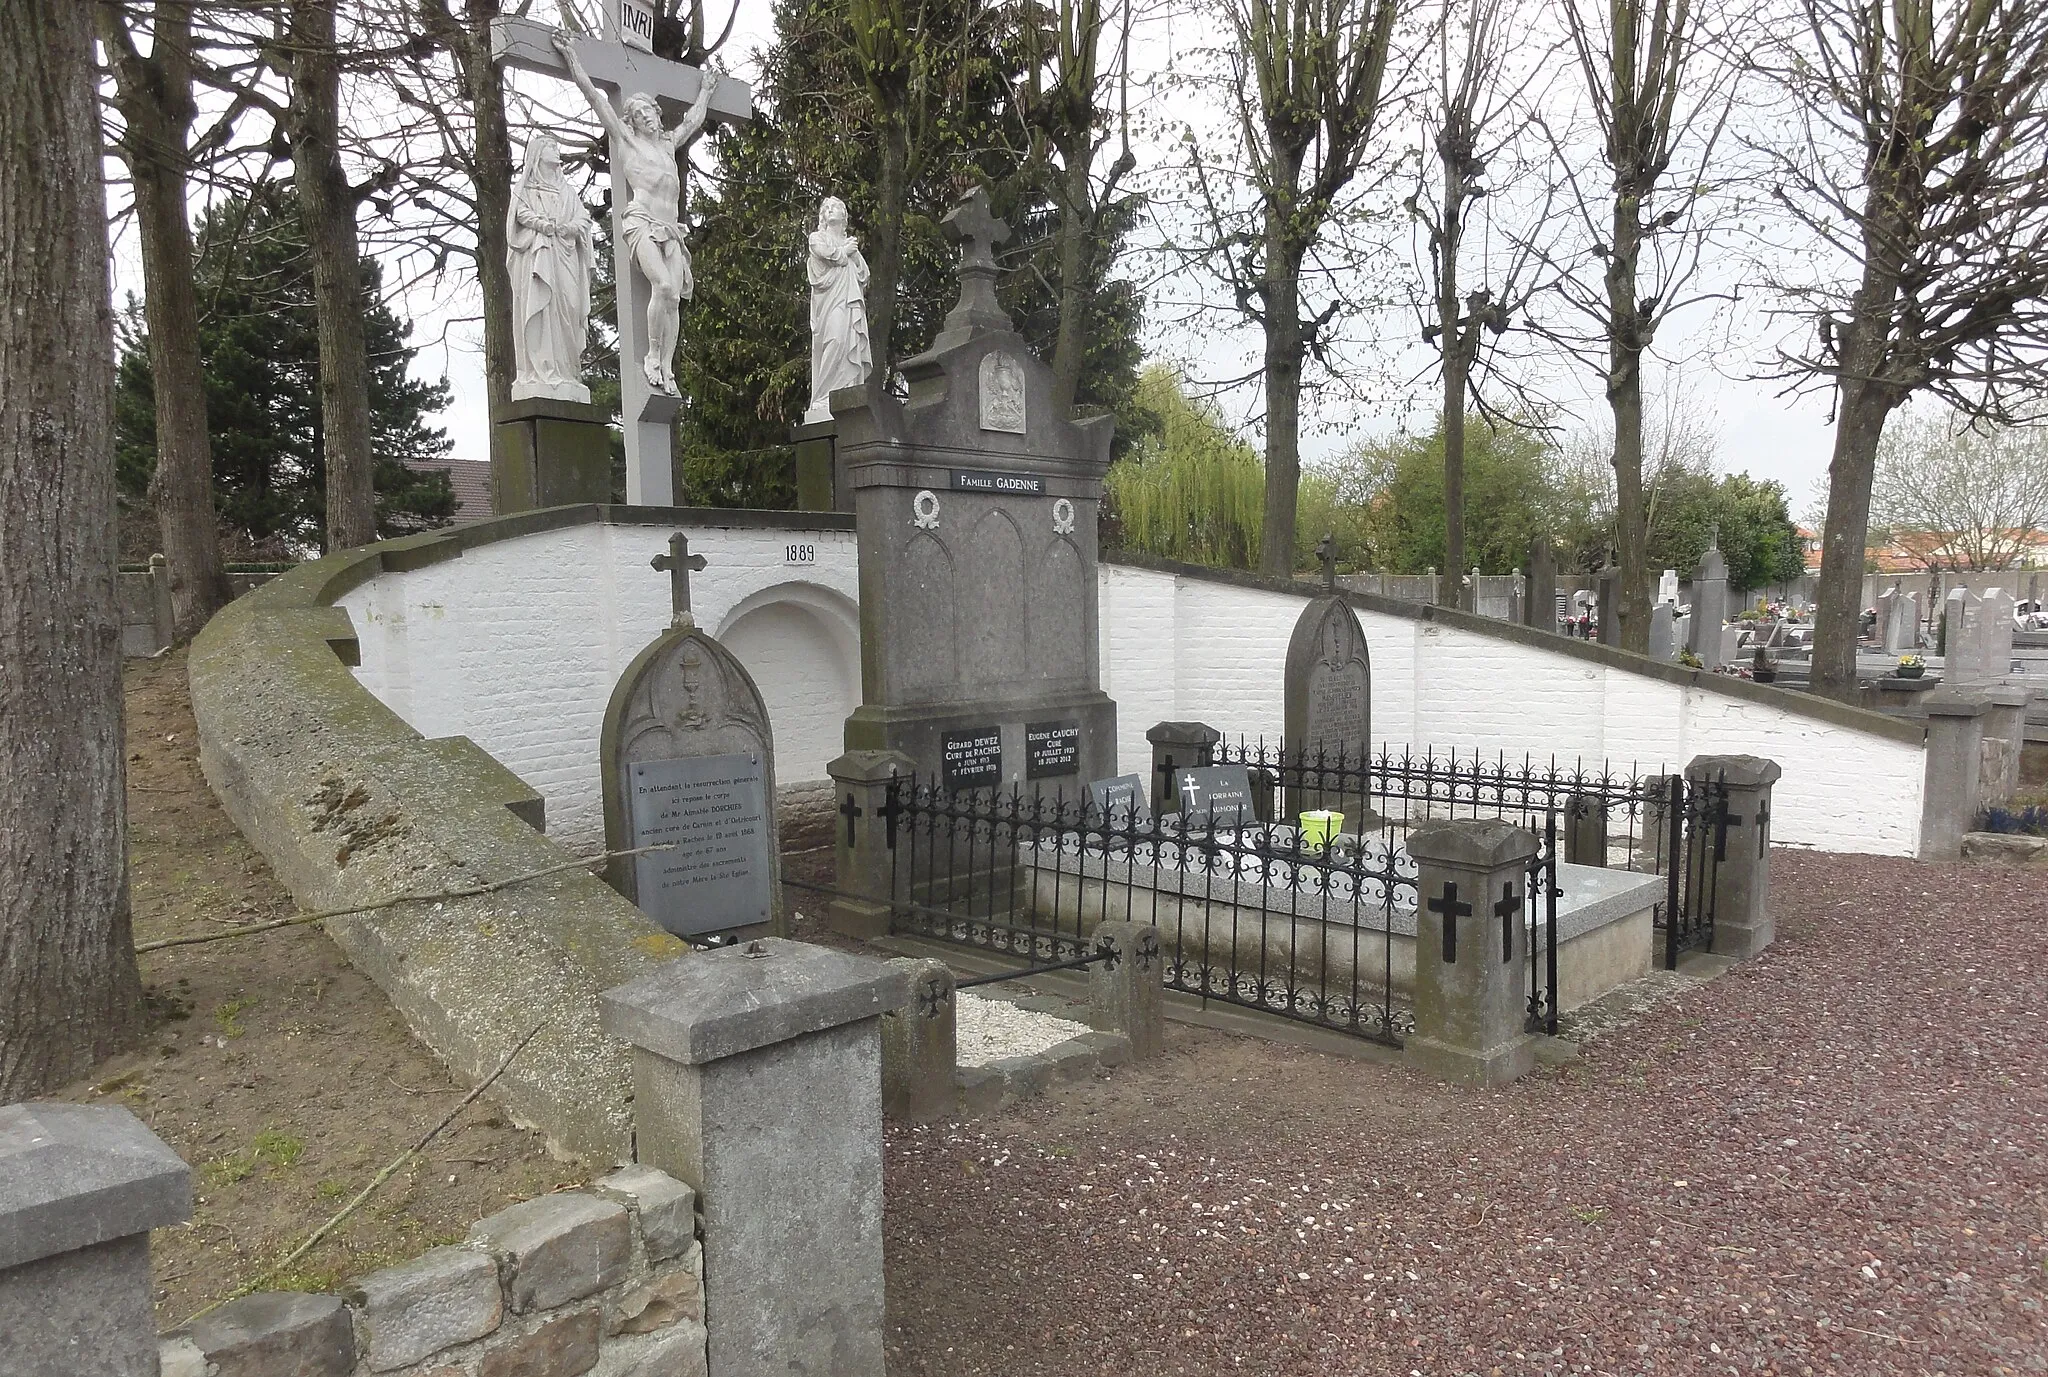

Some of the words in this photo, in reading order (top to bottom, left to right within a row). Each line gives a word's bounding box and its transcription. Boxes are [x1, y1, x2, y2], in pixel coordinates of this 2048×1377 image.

[623, 2, 653, 40] INRI
[961, 475, 993, 488] FAMILLE
[996, 477, 1039, 491] GADENNE
[785, 544, 814, 562] 1889
[1052, 728, 1079, 738] CAUCHY
[974, 736, 998, 747] DEWEZ
[974, 745, 1001, 757] RACHES
[1042, 748, 1062, 757] JUILLET
[964, 758, 977, 766] JUIN
[1045, 757, 1058, 765] JUIN
[639, 786, 648, 794] En
[650, 783, 683, 793] attendant
[684, 781, 691, 790] la
[682, 795, 703, 804] repose
[713, 792, 730, 801] corps
[1208, 791, 1243, 800] LORRAINE
[660, 811, 668, 819] de
[671, 810, 680, 818] Mr
[683, 807, 709, 817] Aimable
[711, 803, 742, 814] DORCHIES
[641, 827, 663, 836] ancien
[682, 823, 690, 831] de
[672, 879, 689, 887] notre
